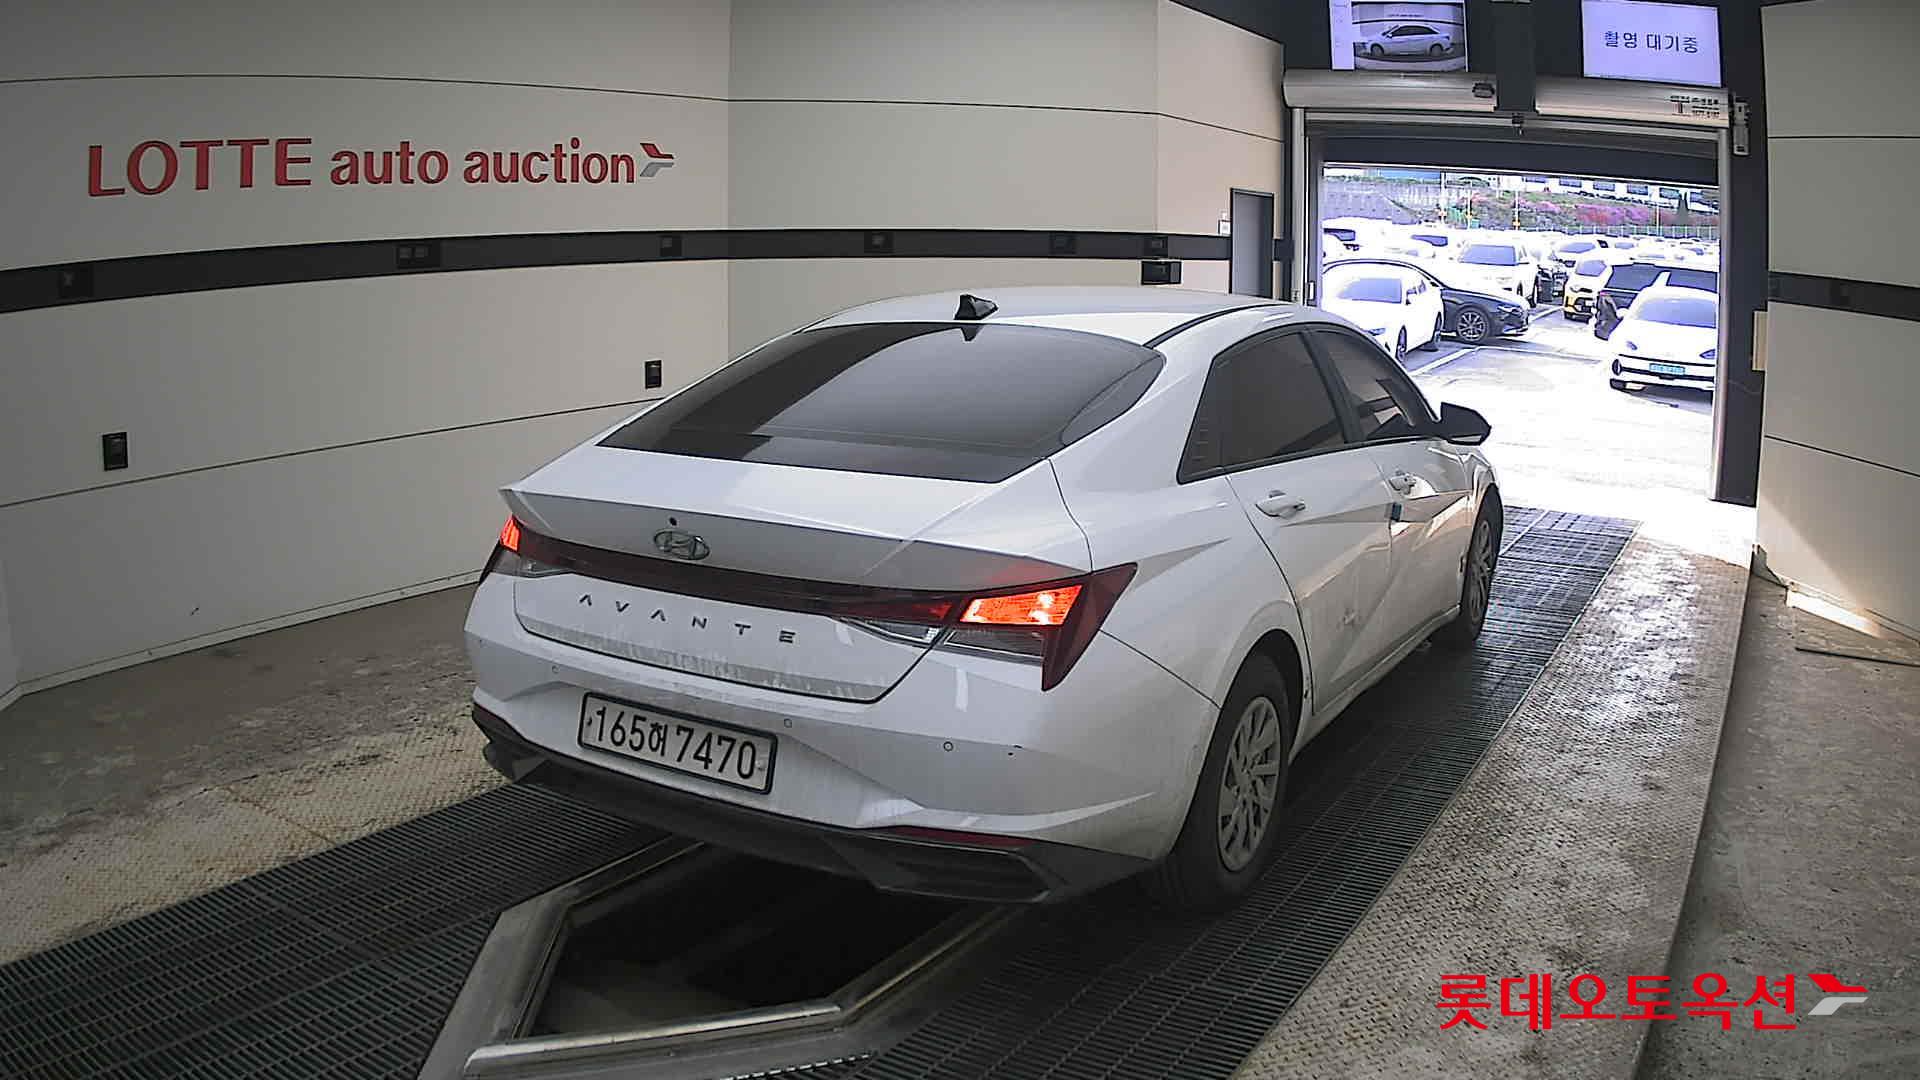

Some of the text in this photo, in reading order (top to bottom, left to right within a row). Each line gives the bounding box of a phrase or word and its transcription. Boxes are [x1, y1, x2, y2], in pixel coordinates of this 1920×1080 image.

[1646, 34, 1698, 54] 대기중
[88, 137, 636, 197] LOTTE auto auction
[579, 594, 796, 644] AVANTE
